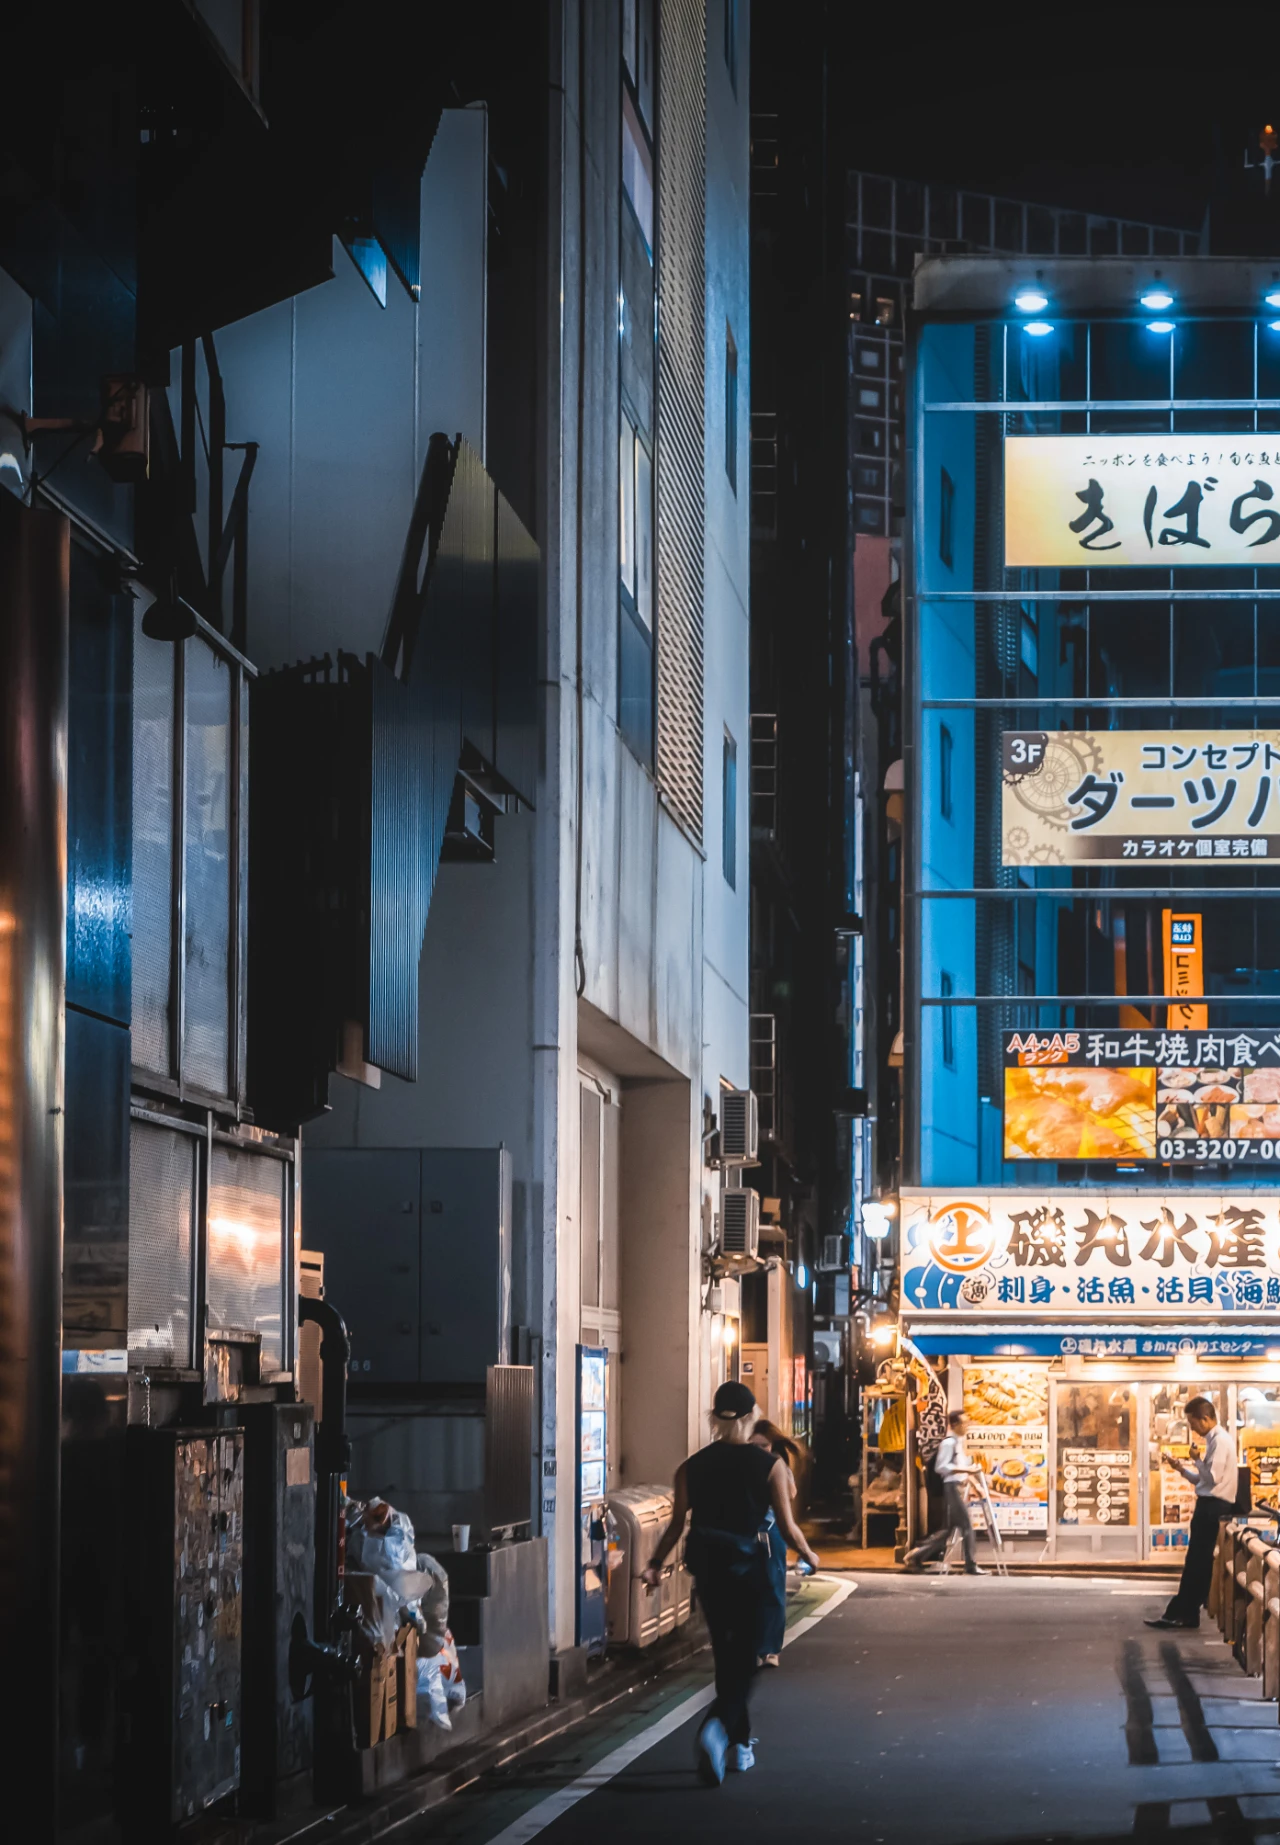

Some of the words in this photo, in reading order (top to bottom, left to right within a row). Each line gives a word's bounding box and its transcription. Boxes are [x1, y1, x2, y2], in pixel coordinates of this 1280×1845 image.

[1010, 740, 1041, 763] 3F
[1121, 838, 1269, 857] カラオケ個室完備
[1024, 1051, 1064, 1065] ランク
